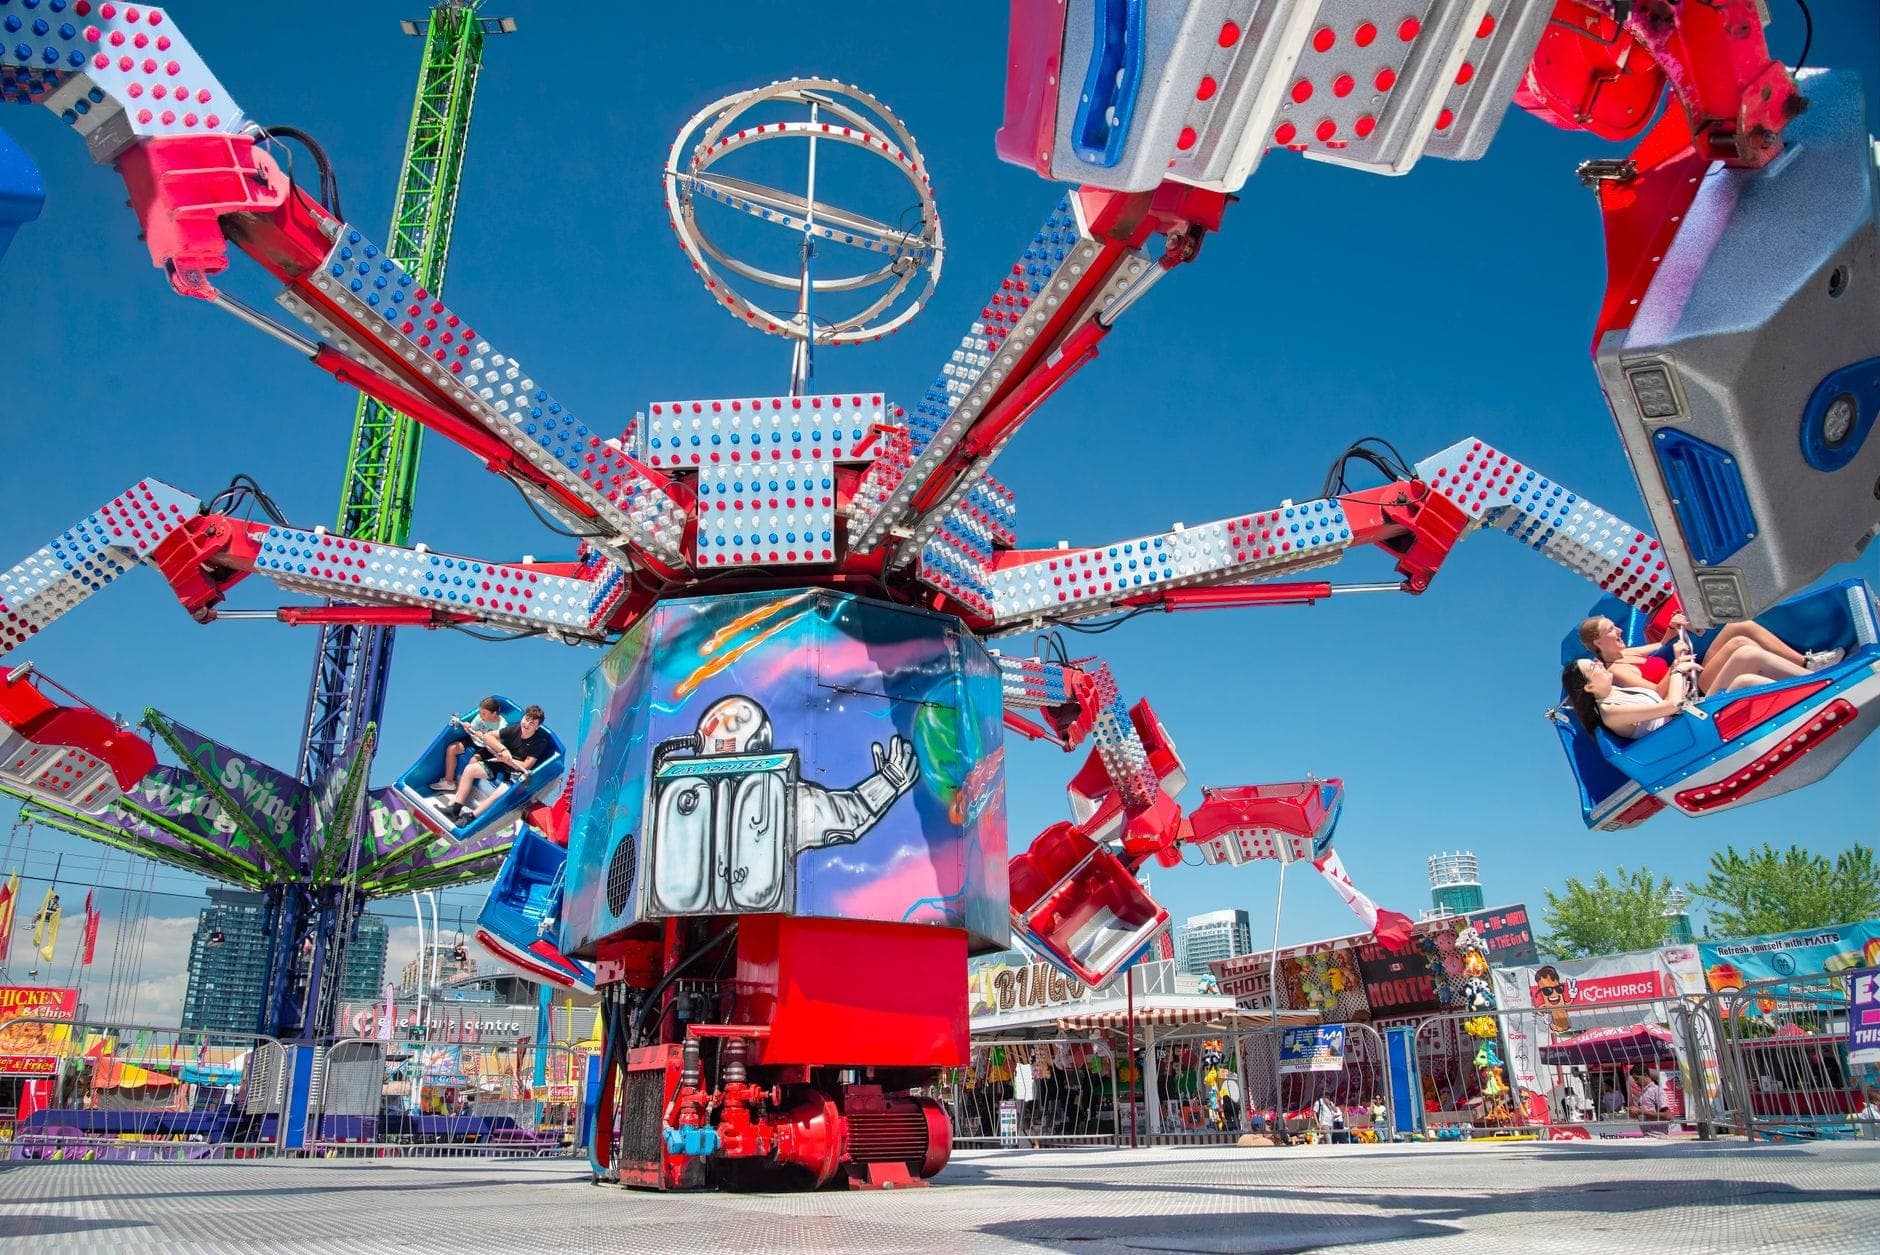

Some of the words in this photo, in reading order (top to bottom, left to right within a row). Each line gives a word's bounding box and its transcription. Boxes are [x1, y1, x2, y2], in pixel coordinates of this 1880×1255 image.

[220, 757, 297, 834] Swing
[1718, 944, 1750, 956] Refresh
[1750, 940, 1783, 954] yourself
[1784, 939, 1802, 949] with
[994, 962, 1085, 1009] BINGO
[1367, 975, 1436, 1009] NORTH
[1598, 981, 1654, 999] CHURROS
[34, 1005, 73, 1018] Chips
[1855, 1029, 1880, 1044] THI
[23, 1058, 54, 1071] Fries
